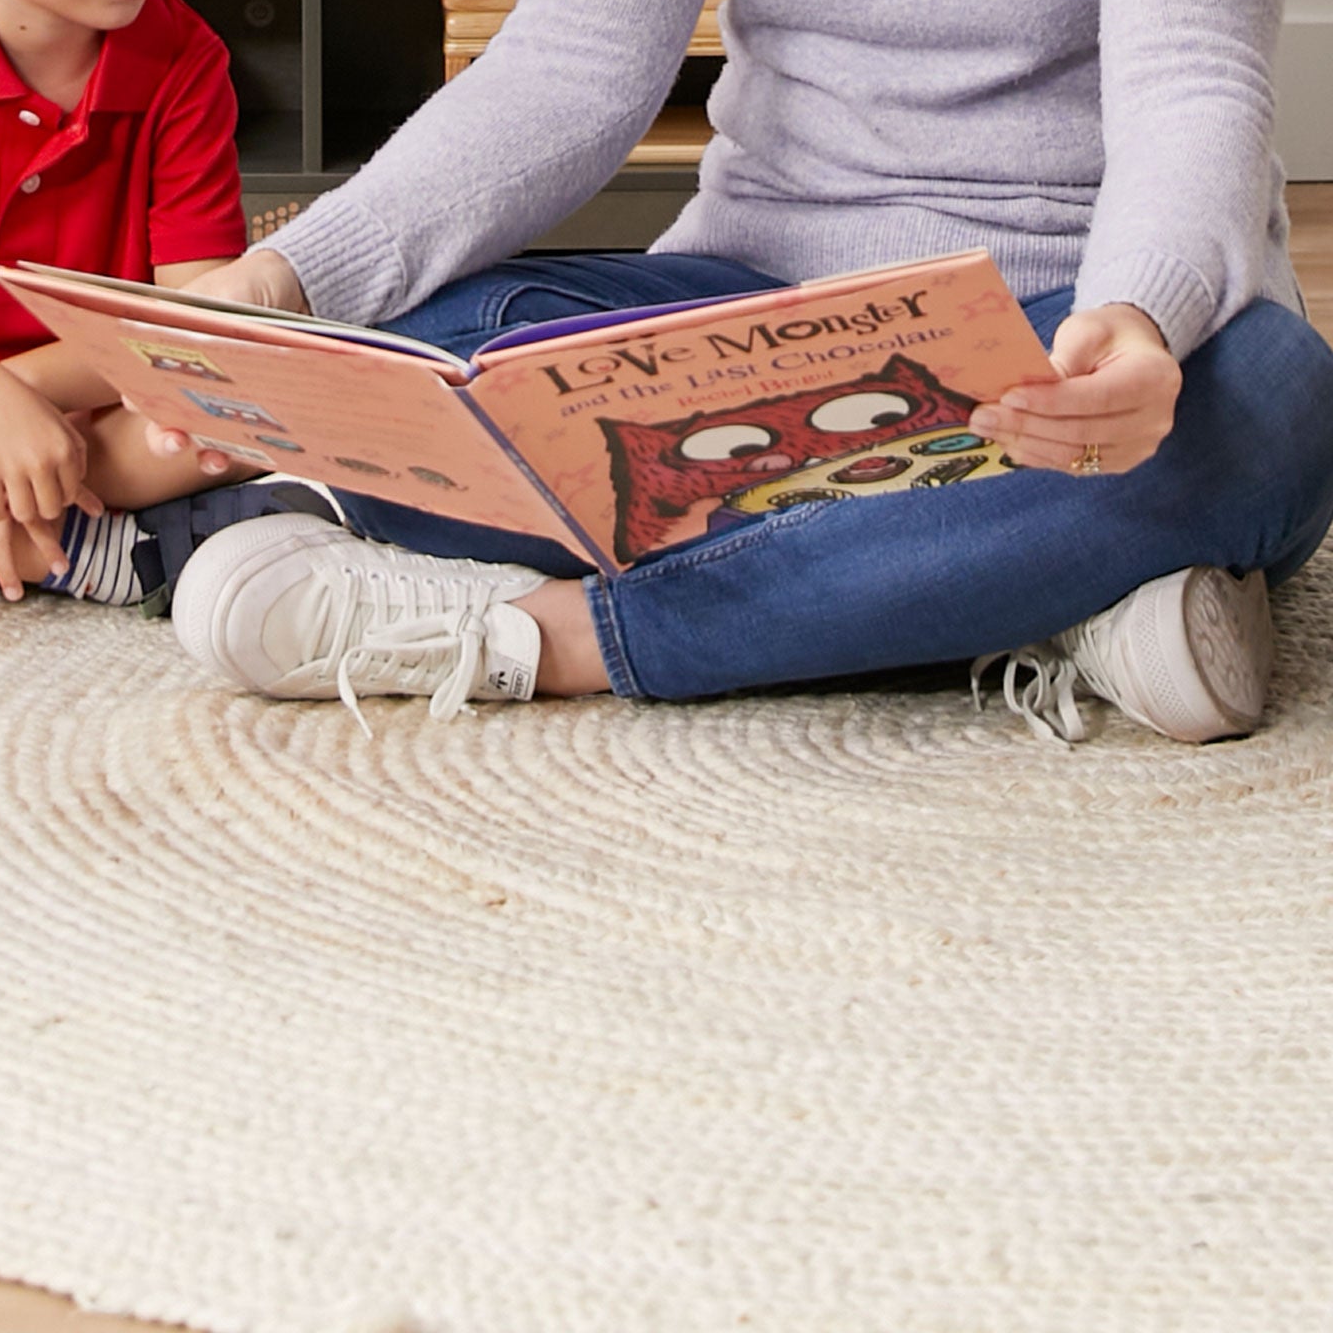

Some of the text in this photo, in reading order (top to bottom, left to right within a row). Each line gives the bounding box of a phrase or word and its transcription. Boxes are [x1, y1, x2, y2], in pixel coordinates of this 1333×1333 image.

[703, 289, 928, 359] Monster
[560, 393, 610, 418] and
[618, 381, 674, 401] the
[685, 362, 758, 389] Last
